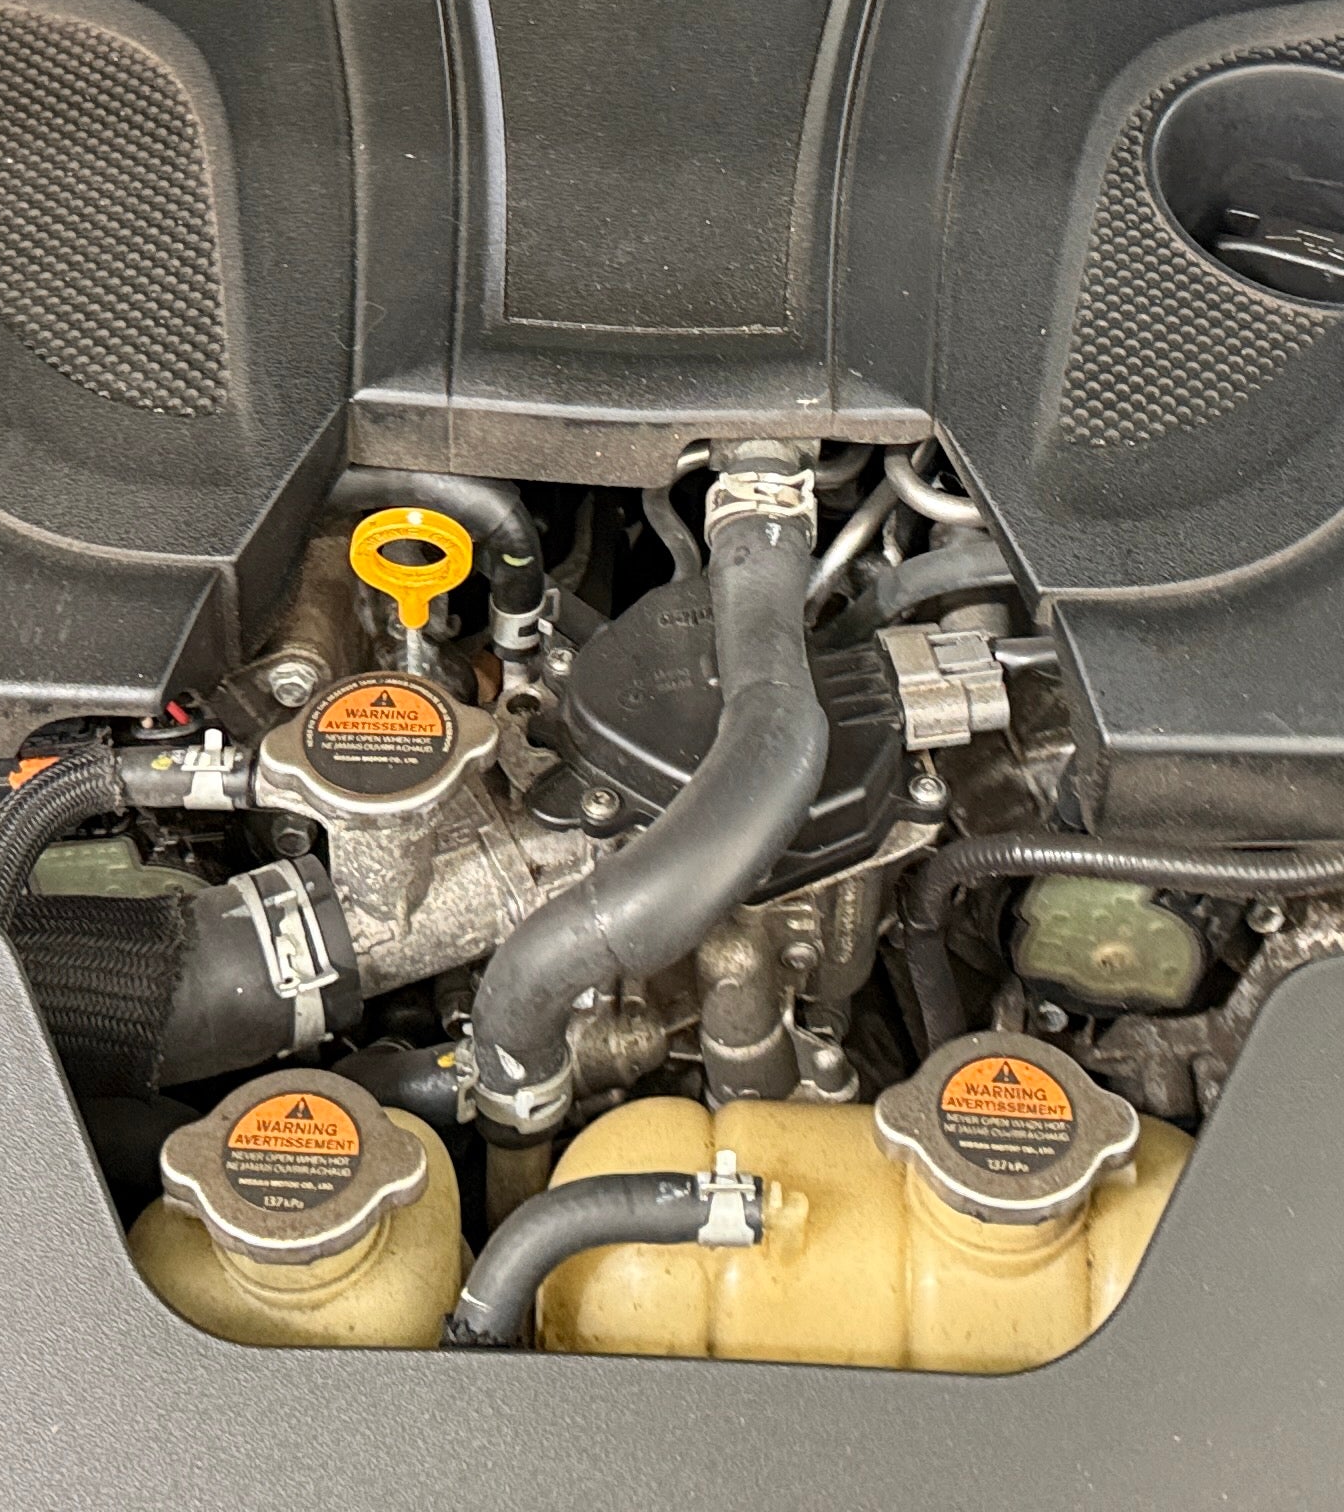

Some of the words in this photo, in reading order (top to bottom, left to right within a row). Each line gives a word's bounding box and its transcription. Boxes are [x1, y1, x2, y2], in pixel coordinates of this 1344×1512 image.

[345, 708, 419, 721] WARNING
[325, 720, 436, 733] AVERTISSEMENT
[325, 733, 355, 742] NEVER
[355, 734, 381, 743] OPEN
[382, 735, 411, 744] WHEN
[965, 1082, 1048, 1101] WARNING
[947, 1096, 1067, 1115] AVERTISSEMENT
[256, 1120, 338, 1136] WARNING
[235, 1134, 355, 1151] AVERTISSEMENT
[231, 1150, 264, 1161] NEVER
[265, 1152, 294, 1163] OPEN
[296, 1154, 327, 1165] WHEN
